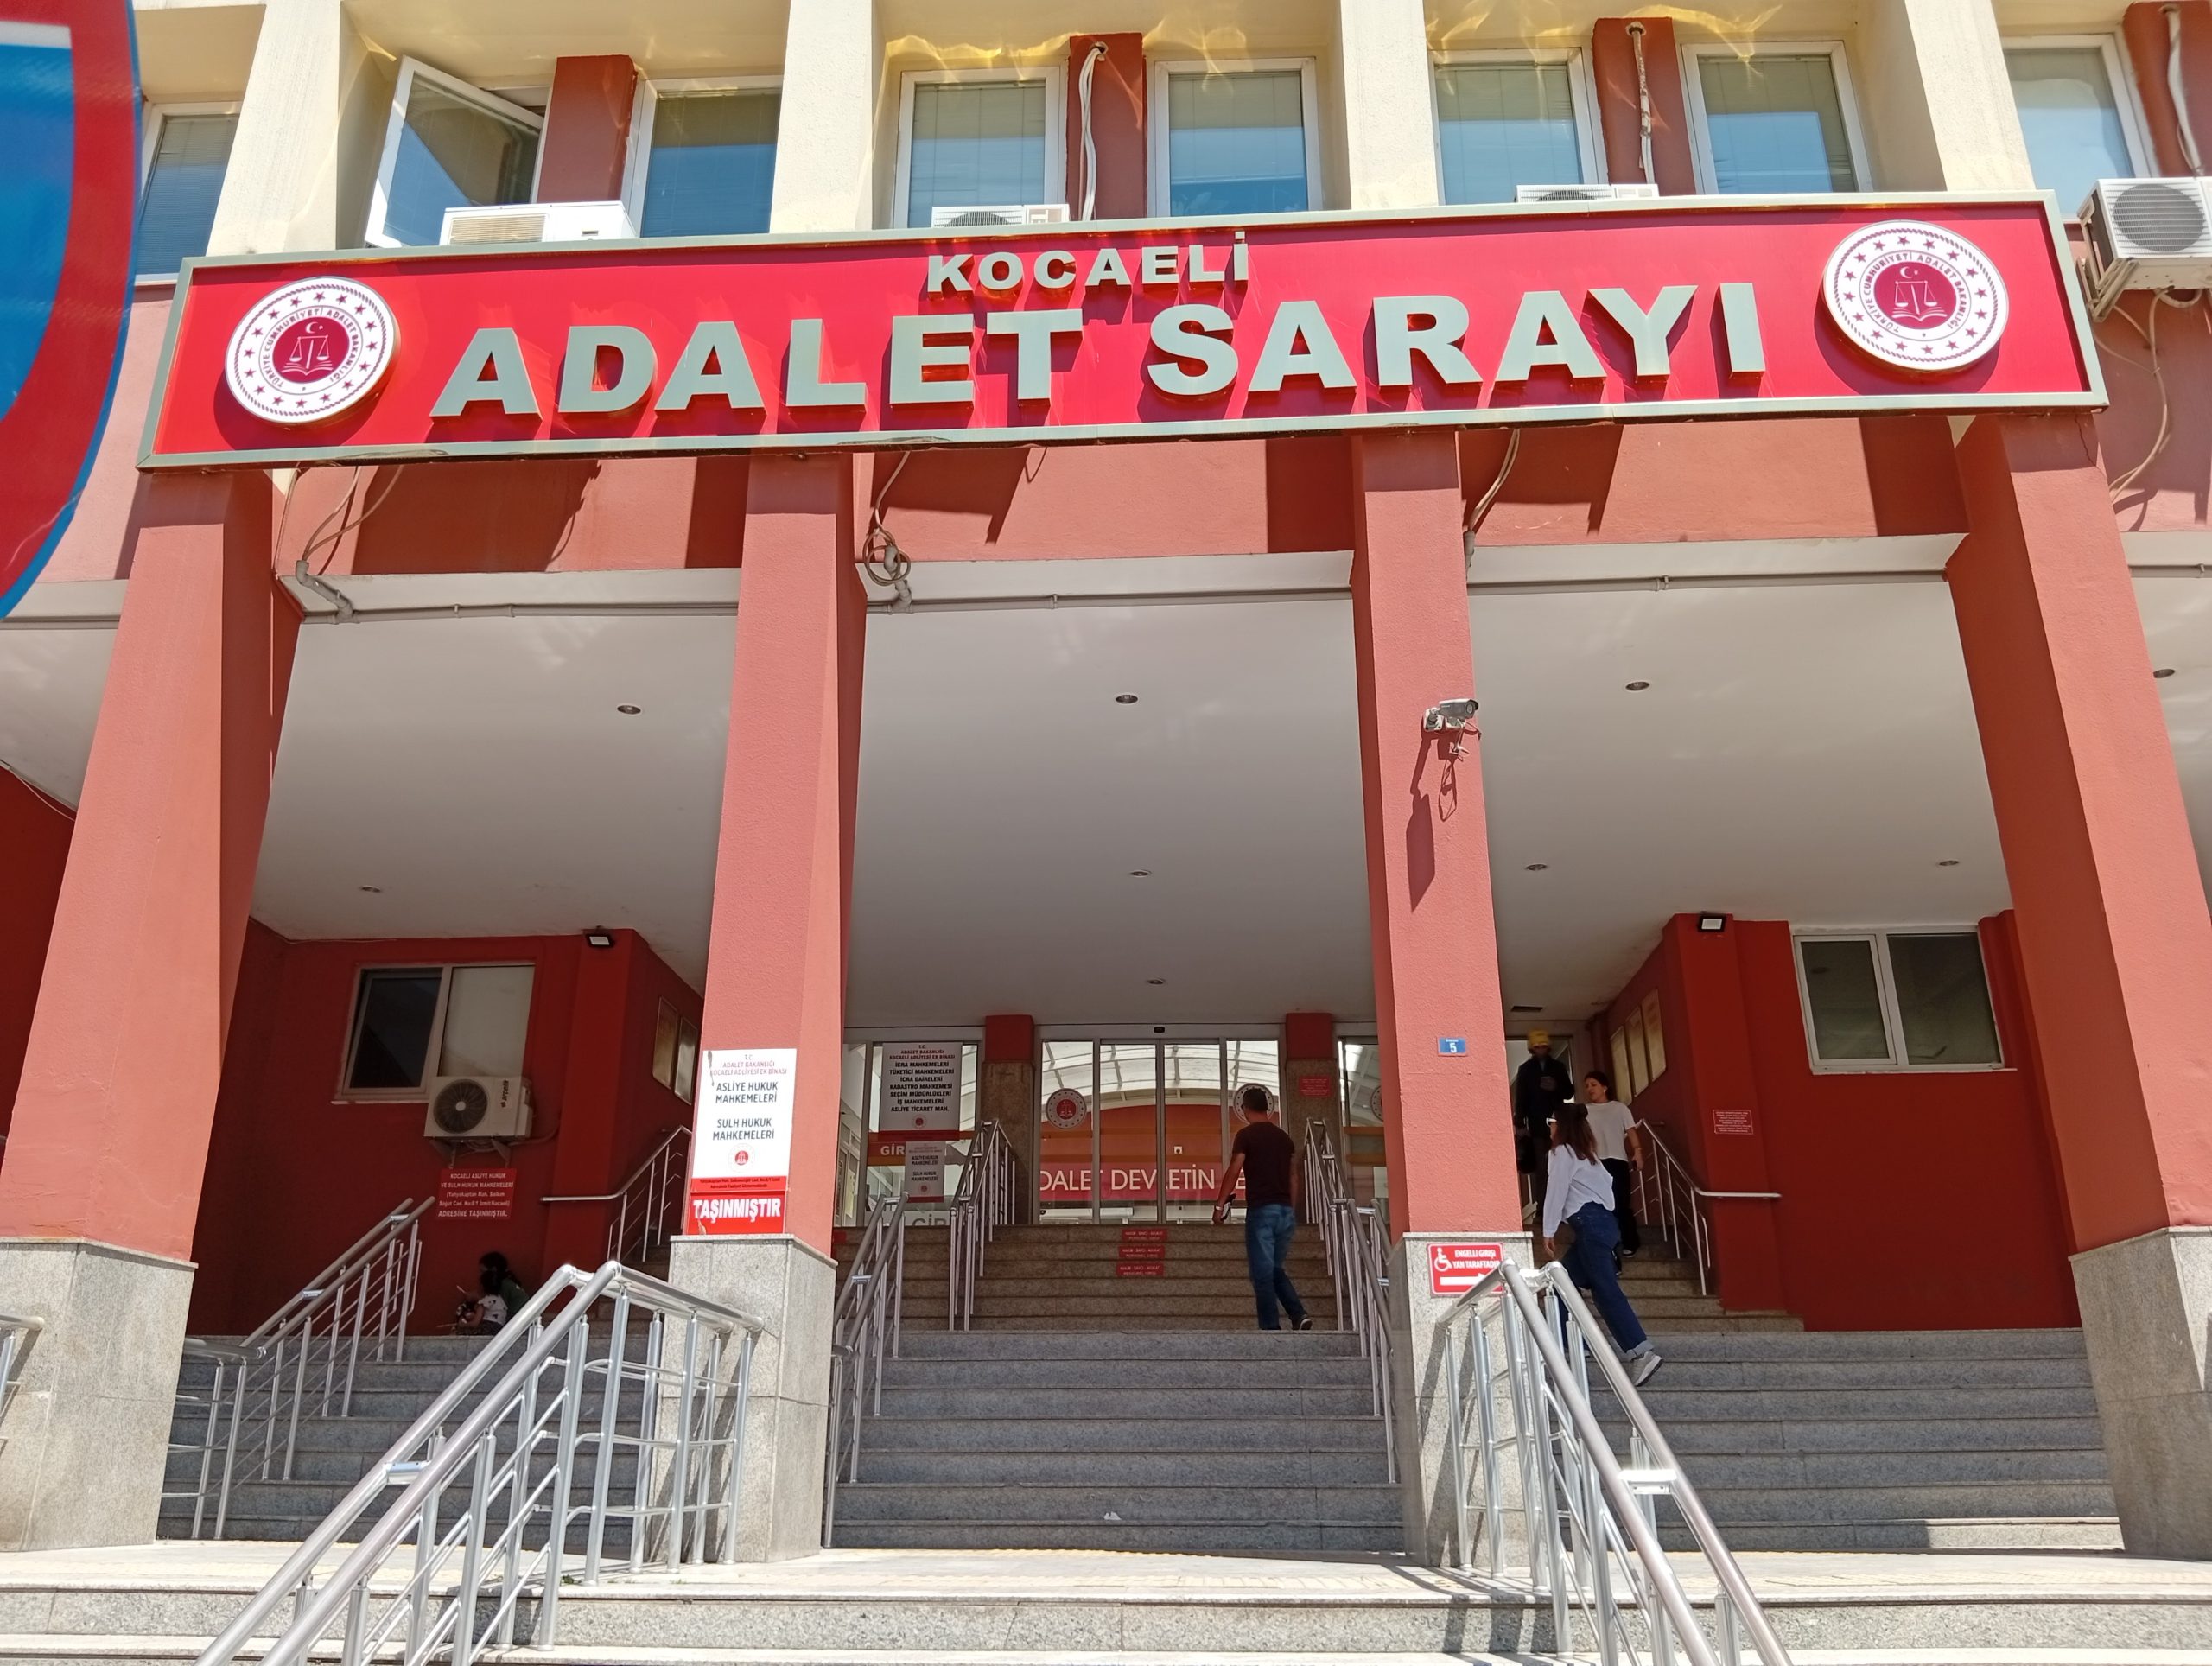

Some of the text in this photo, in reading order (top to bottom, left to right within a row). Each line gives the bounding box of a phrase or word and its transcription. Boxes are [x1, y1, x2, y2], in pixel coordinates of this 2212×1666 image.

[927, 232, 1249, 294] KOCAELİ
[1865, 297, 1900, 334] TÜRKİYE
[1916, 254, 1957, 283] ADALET
[1948, 281, 1966, 330] BAKANLIĞI
[326, 309, 357, 334] ADALET
[329, 334, 359, 383] BAKANLIĞI
[429, 283, 1767, 418] ADALET SARAYI
[262, 354, 285, 388] TÜRKİYE
[1449, 1042, 1457, 1053] 5
[715, 1091, 777, 1103] MAHKEMELERİ
[716, 1081, 779, 1091] ASLİYE HUKUK
[713, 1129, 774, 1141] MAHKEMELERİ
[716, 1118, 772, 1128] SULH HUKUK
[1111, 1164, 1215, 1191] DEVETİN
[693, 1198, 781, 1224] TAŞINMIŞTIR
